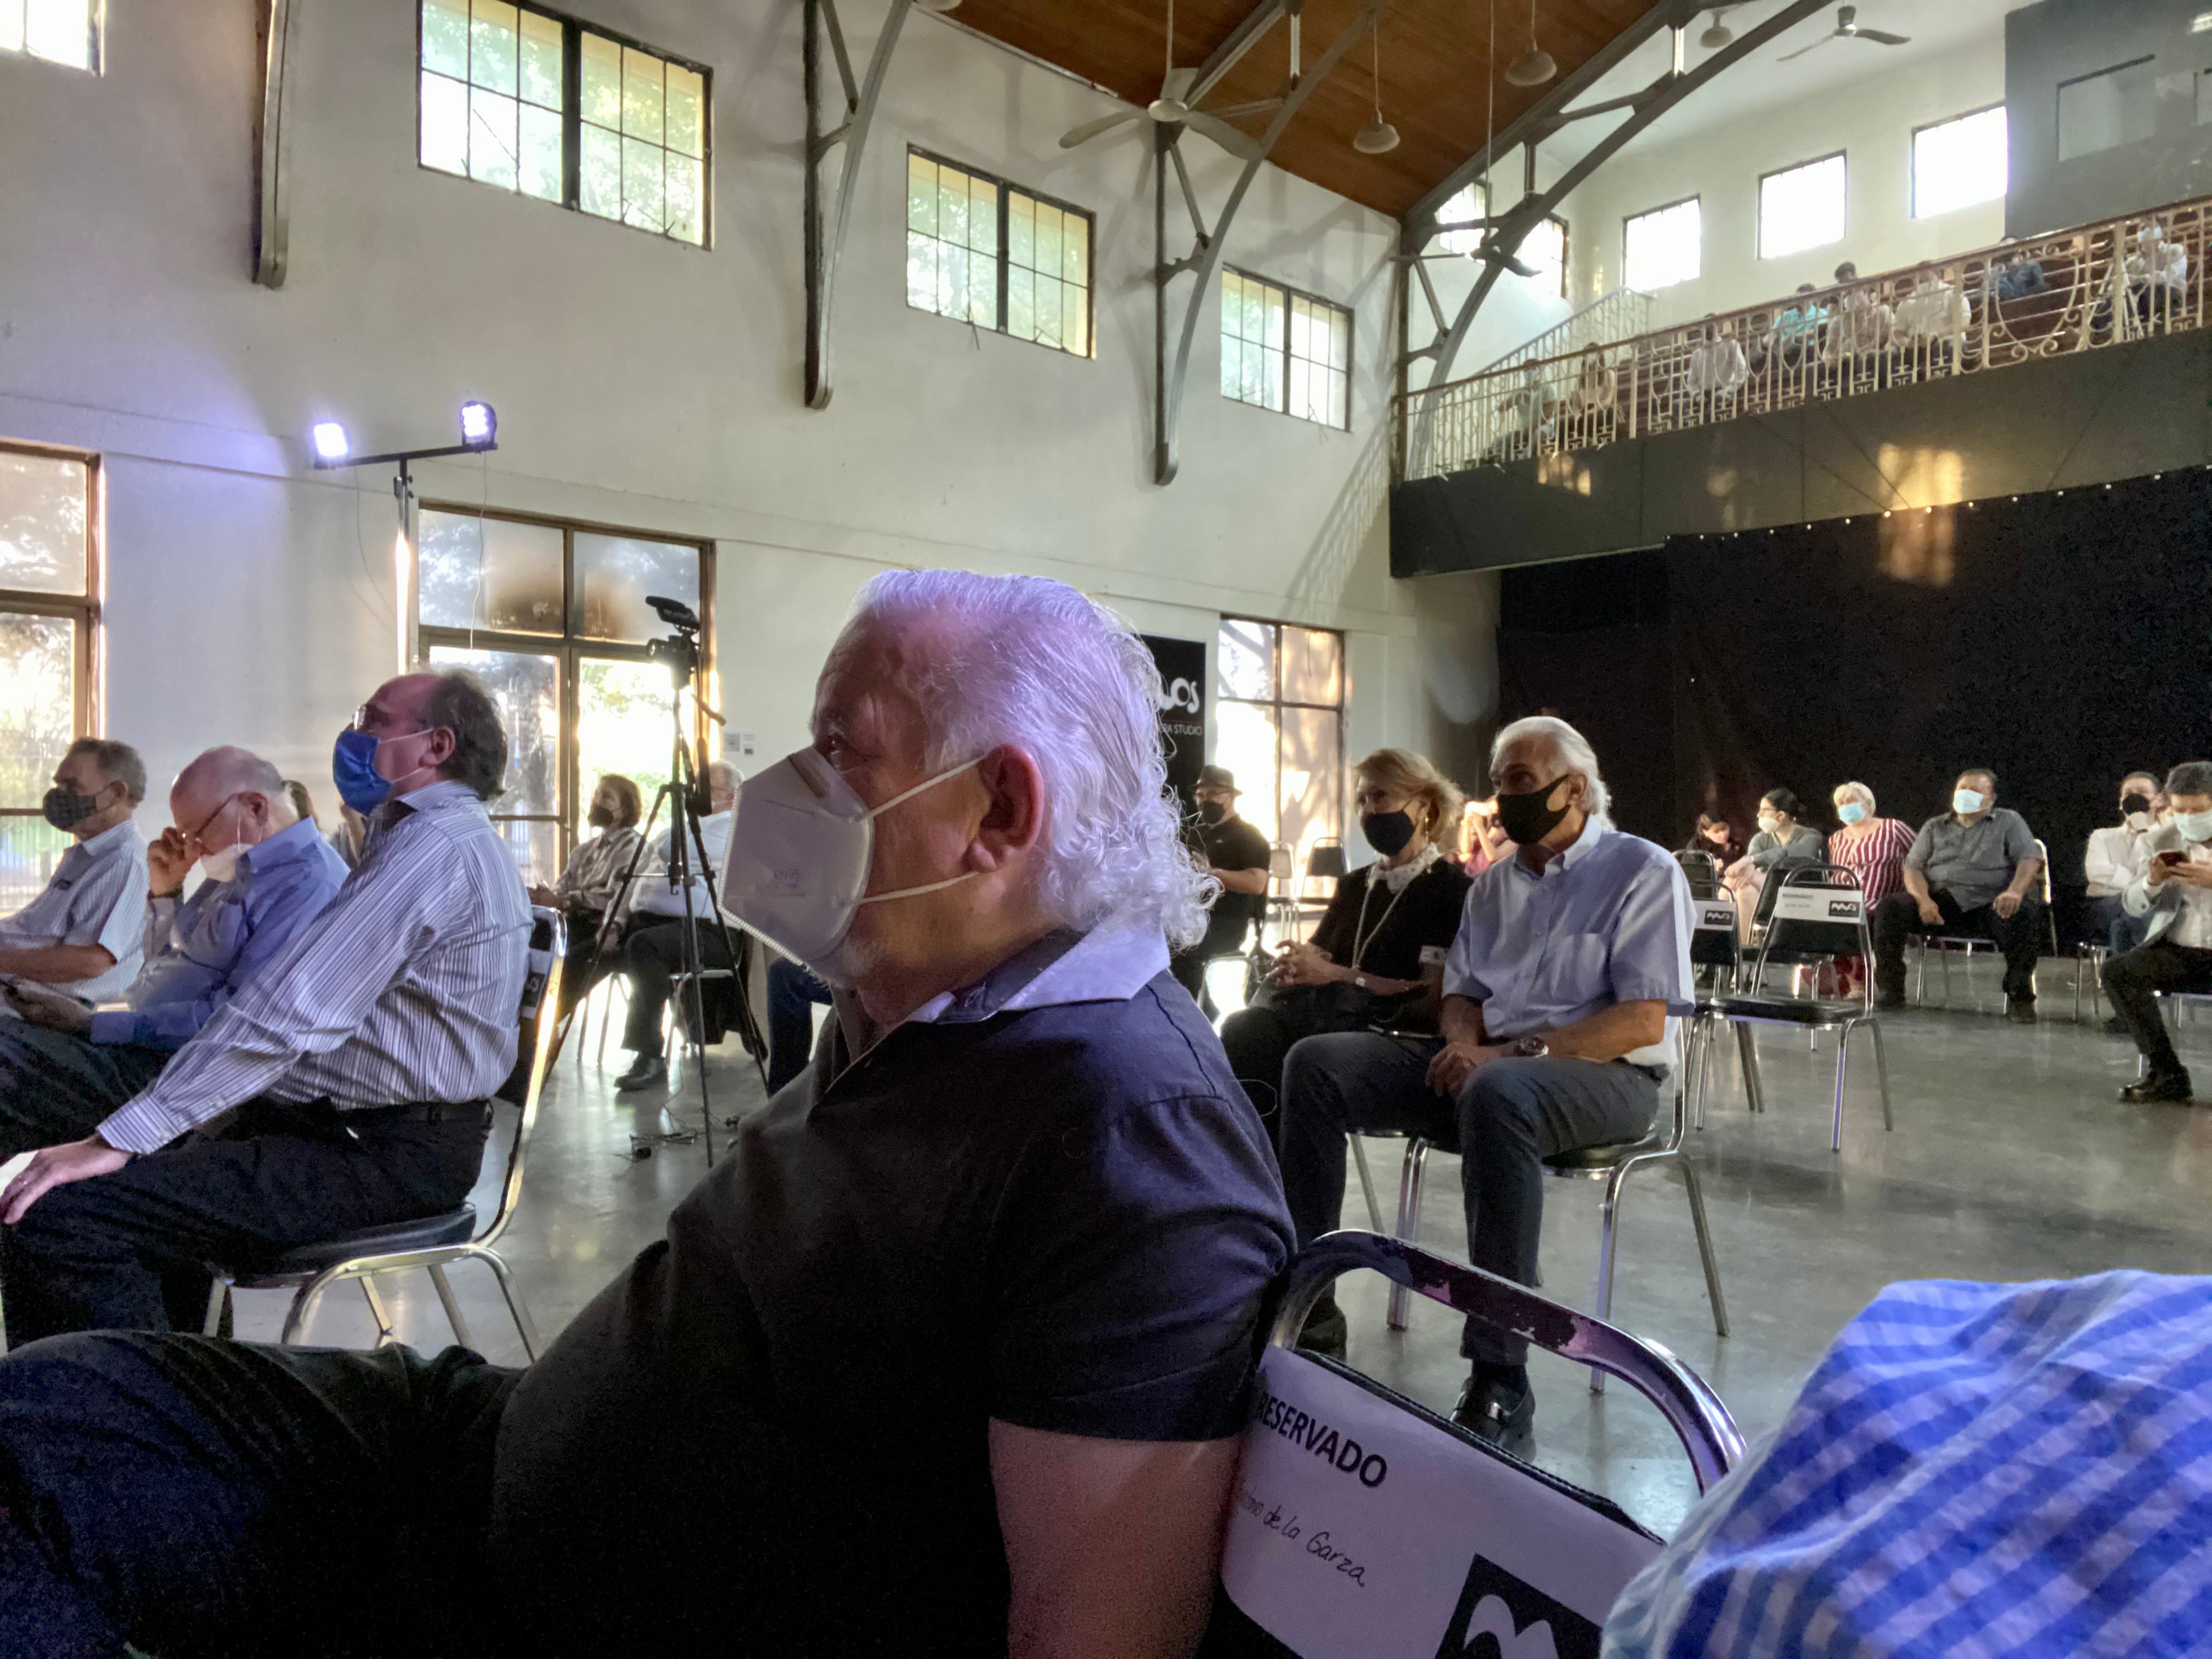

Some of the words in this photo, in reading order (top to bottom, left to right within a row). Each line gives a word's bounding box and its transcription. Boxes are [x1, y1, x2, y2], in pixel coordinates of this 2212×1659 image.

[1173, 724, 1203, 736] STUDIO
[1258, 1392, 1387, 1488] RESERVADO
[1263, 1505, 1282, 1529] de
[1282, 1515, 1301, 1539] la
[1306, 1530, 1365, 1587] Garza
